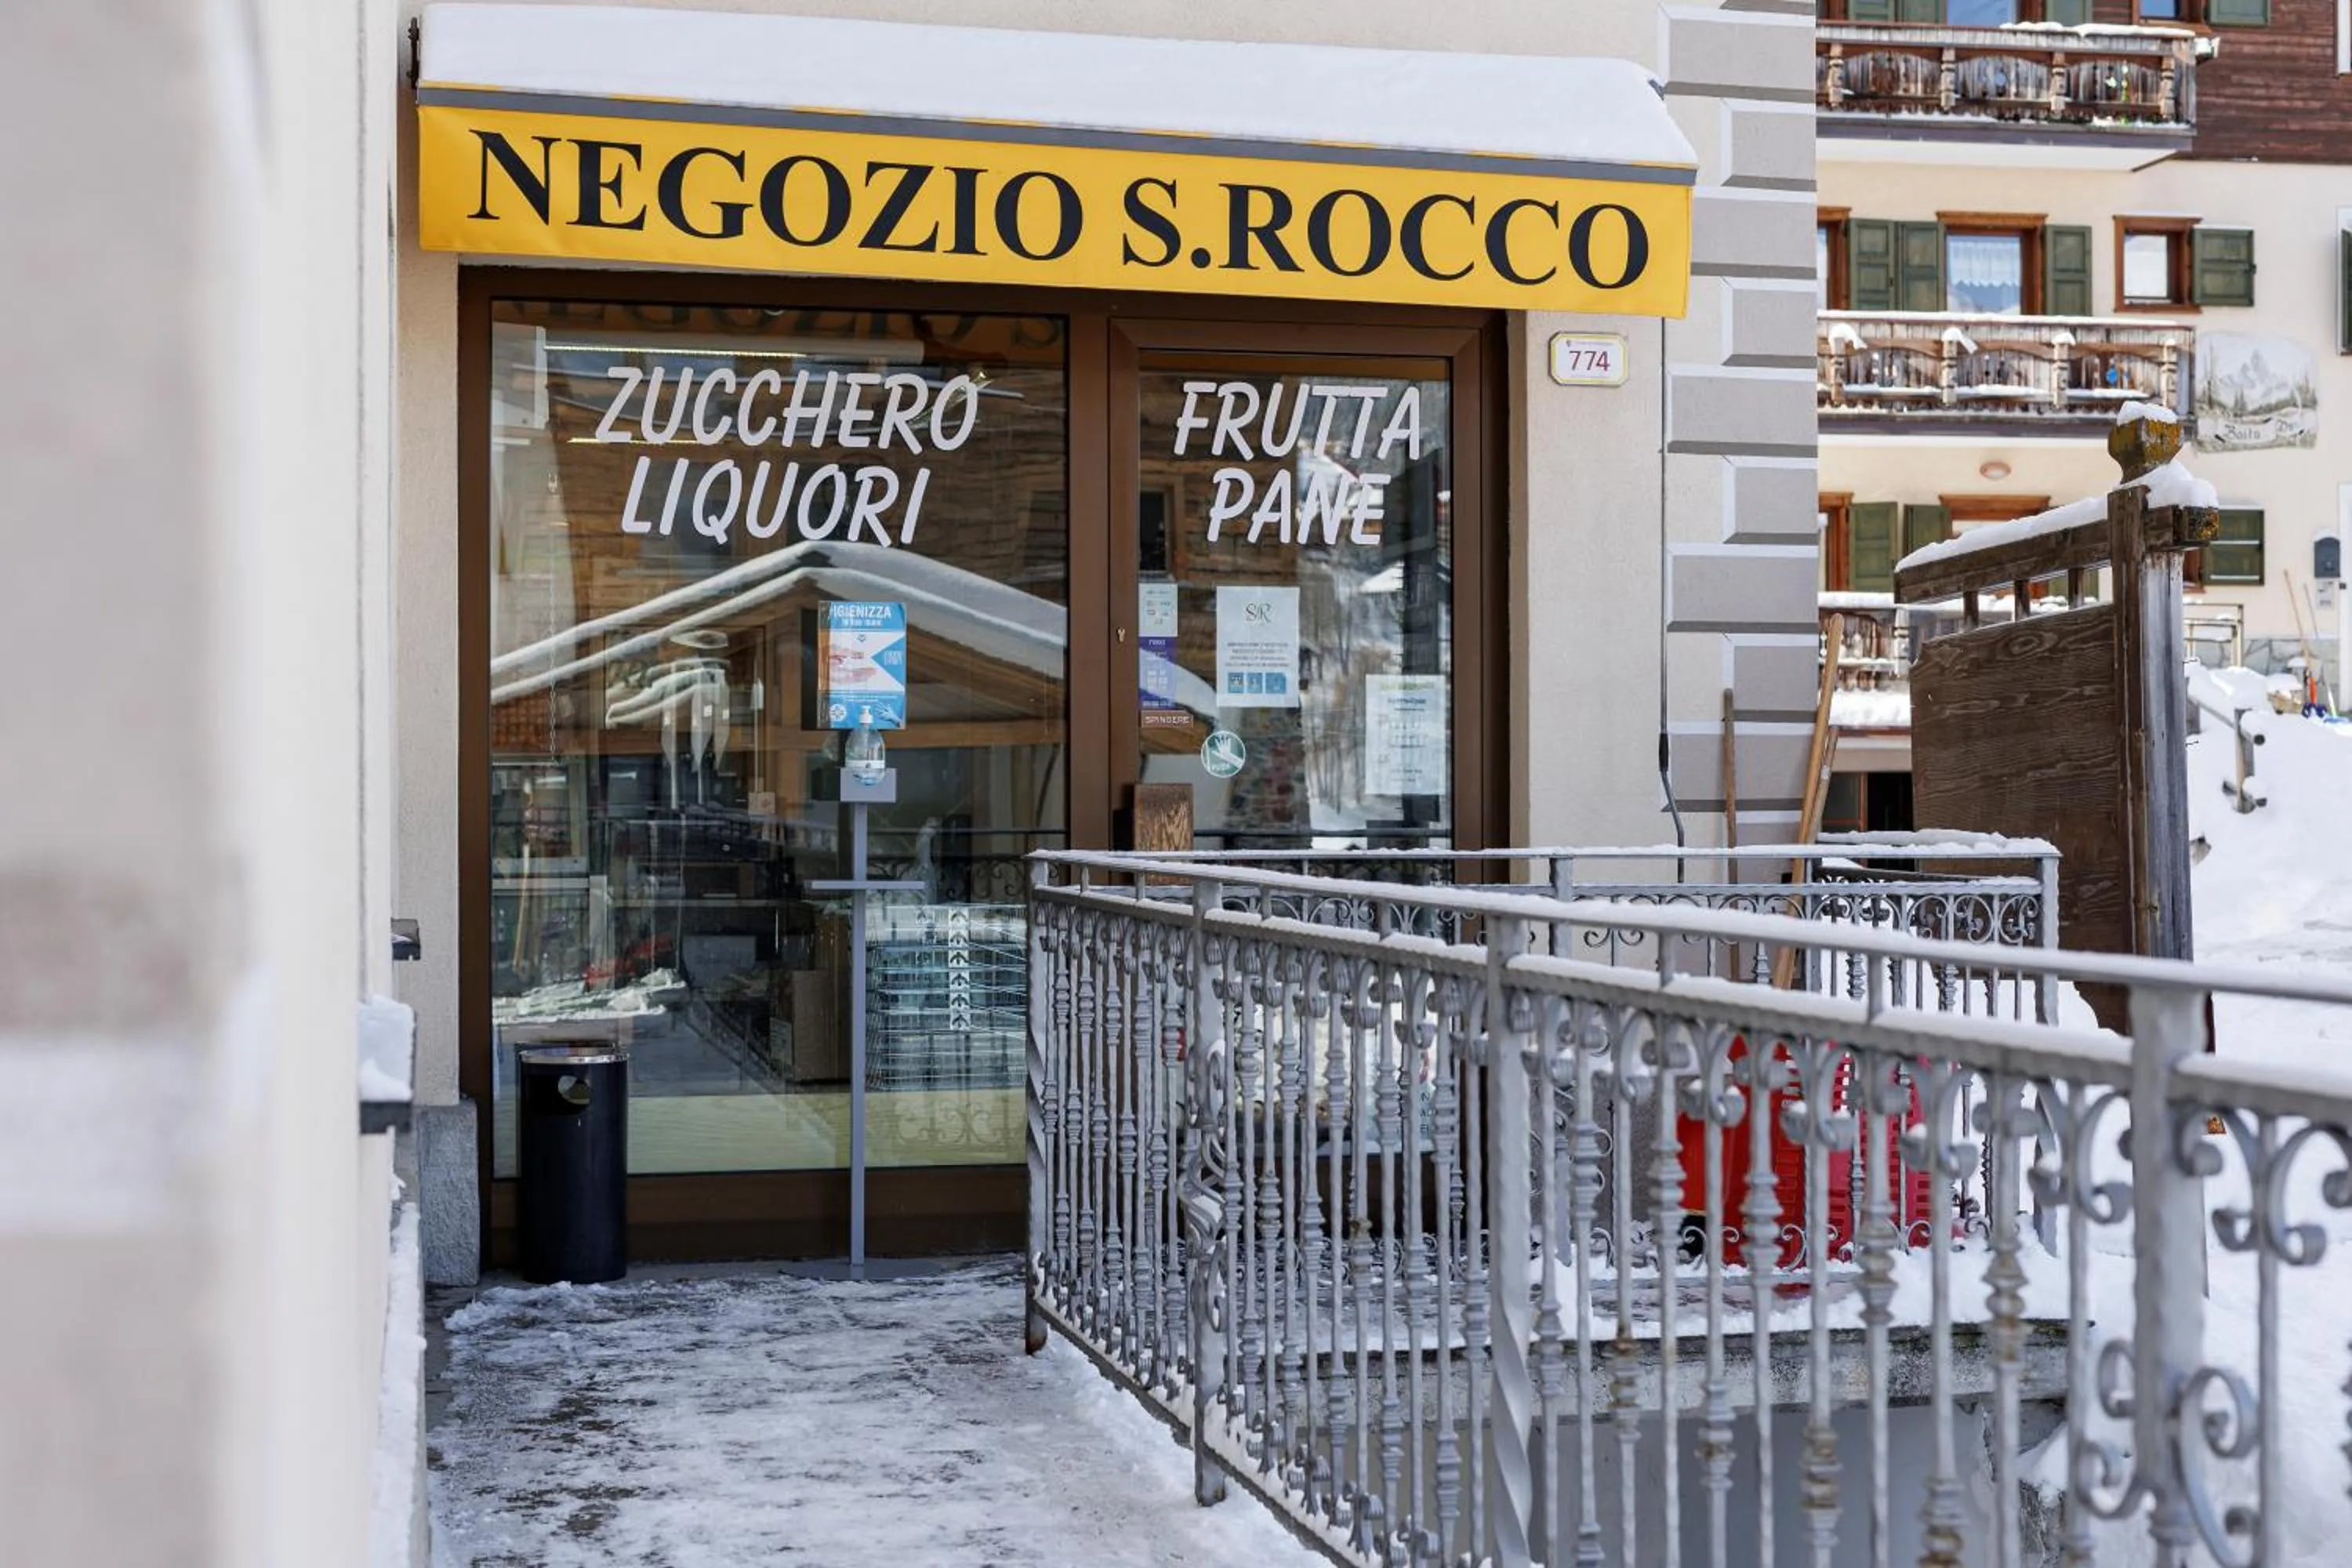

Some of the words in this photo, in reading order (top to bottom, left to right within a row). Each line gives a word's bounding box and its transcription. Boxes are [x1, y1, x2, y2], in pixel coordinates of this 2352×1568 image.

[466, 129, 1083, 261] NEGOZIO
[1122, 176, 1650, 289] S.ROCCO
[1569, 350, 1610, 372] 774
[594, 365, 979, 456] ZUCCHERO
[1173, 381, 1421, 461] FRUTTA
[621, 456, 931, 547] LIQUORI
[1207, 467, 1392, 546] PANE
